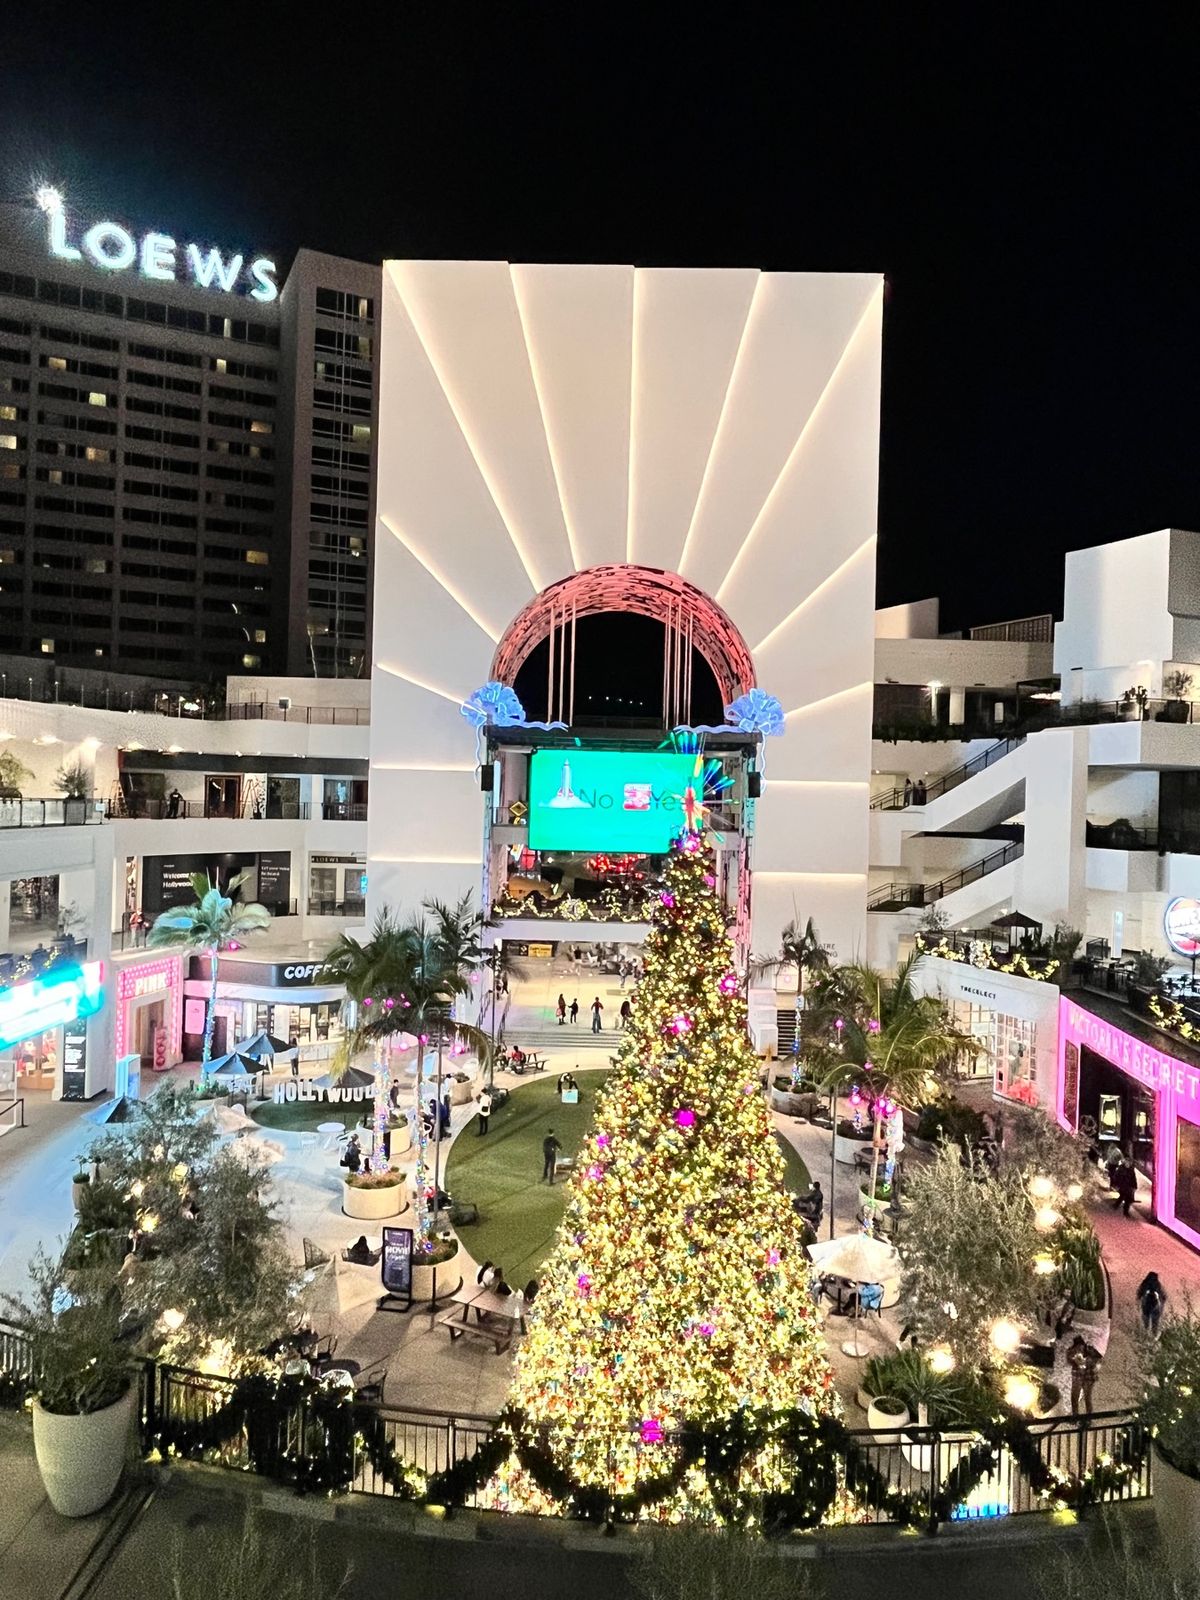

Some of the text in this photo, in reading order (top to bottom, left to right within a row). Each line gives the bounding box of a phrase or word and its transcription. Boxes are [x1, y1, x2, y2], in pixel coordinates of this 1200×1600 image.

[44, 188, 277, 302] LOEWS
[579, 788, 613, 808] No
[135, 972, 167, 996] PINK
[284, 964, 339, 980] COFFE
[1132, 1043, 1200, 1100] SECRET
[273, 1079, 377, 1104] HOLLYWOOD
